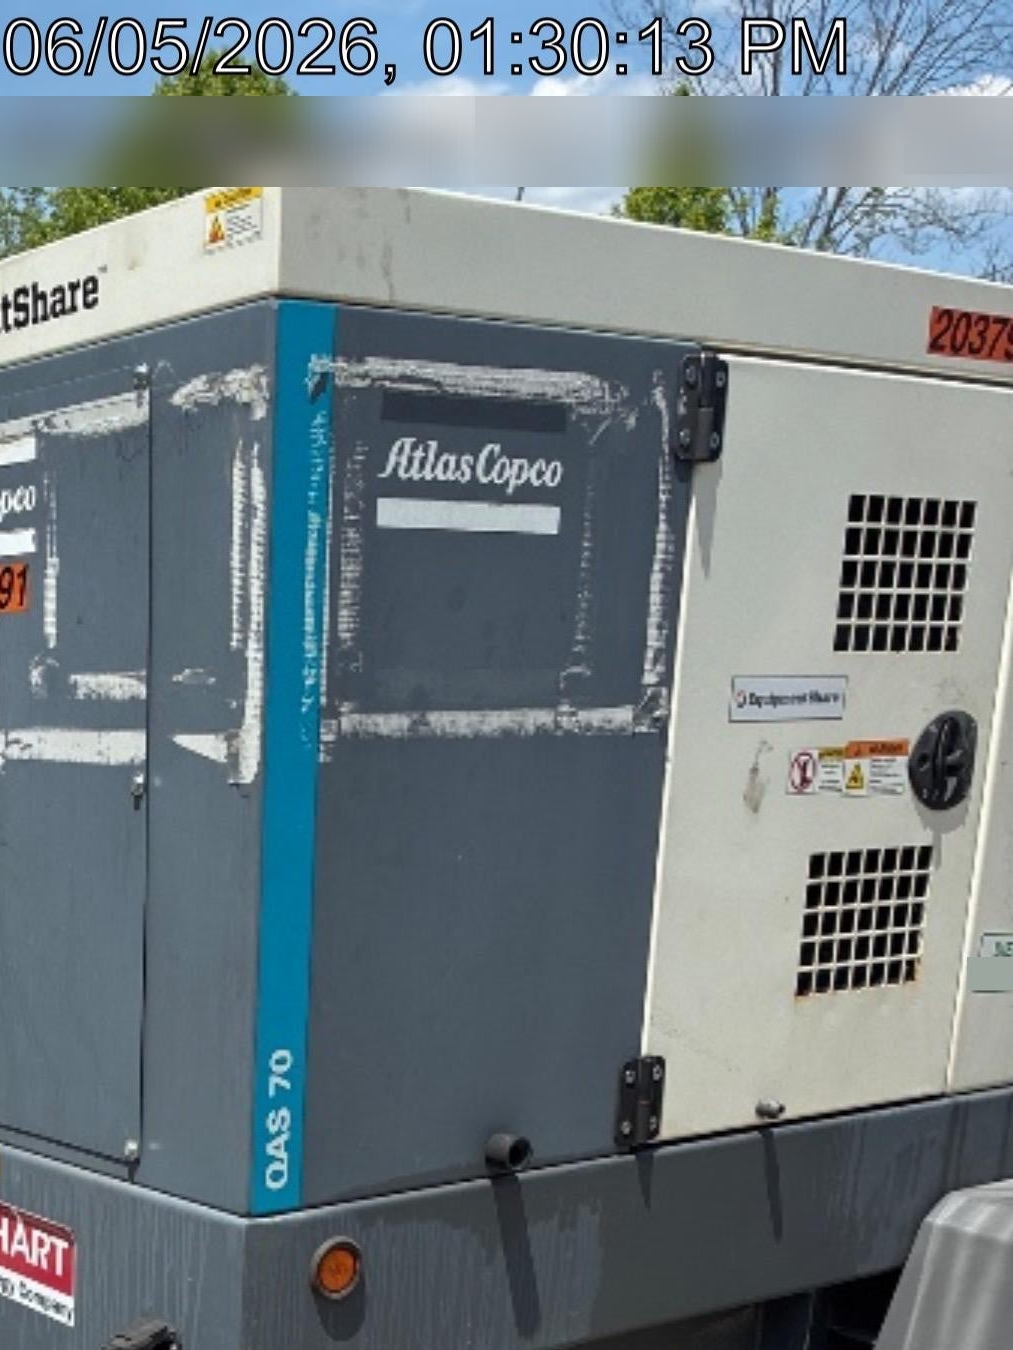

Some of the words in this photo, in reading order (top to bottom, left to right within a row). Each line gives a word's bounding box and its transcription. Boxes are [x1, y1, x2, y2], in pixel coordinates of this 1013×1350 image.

[377, 437, 474, 483] Atlas
[476, 443, 563, 495] Copco
[268, 1049, 294, 1099] 70
[265, 1106, 291, 1191] QAS
